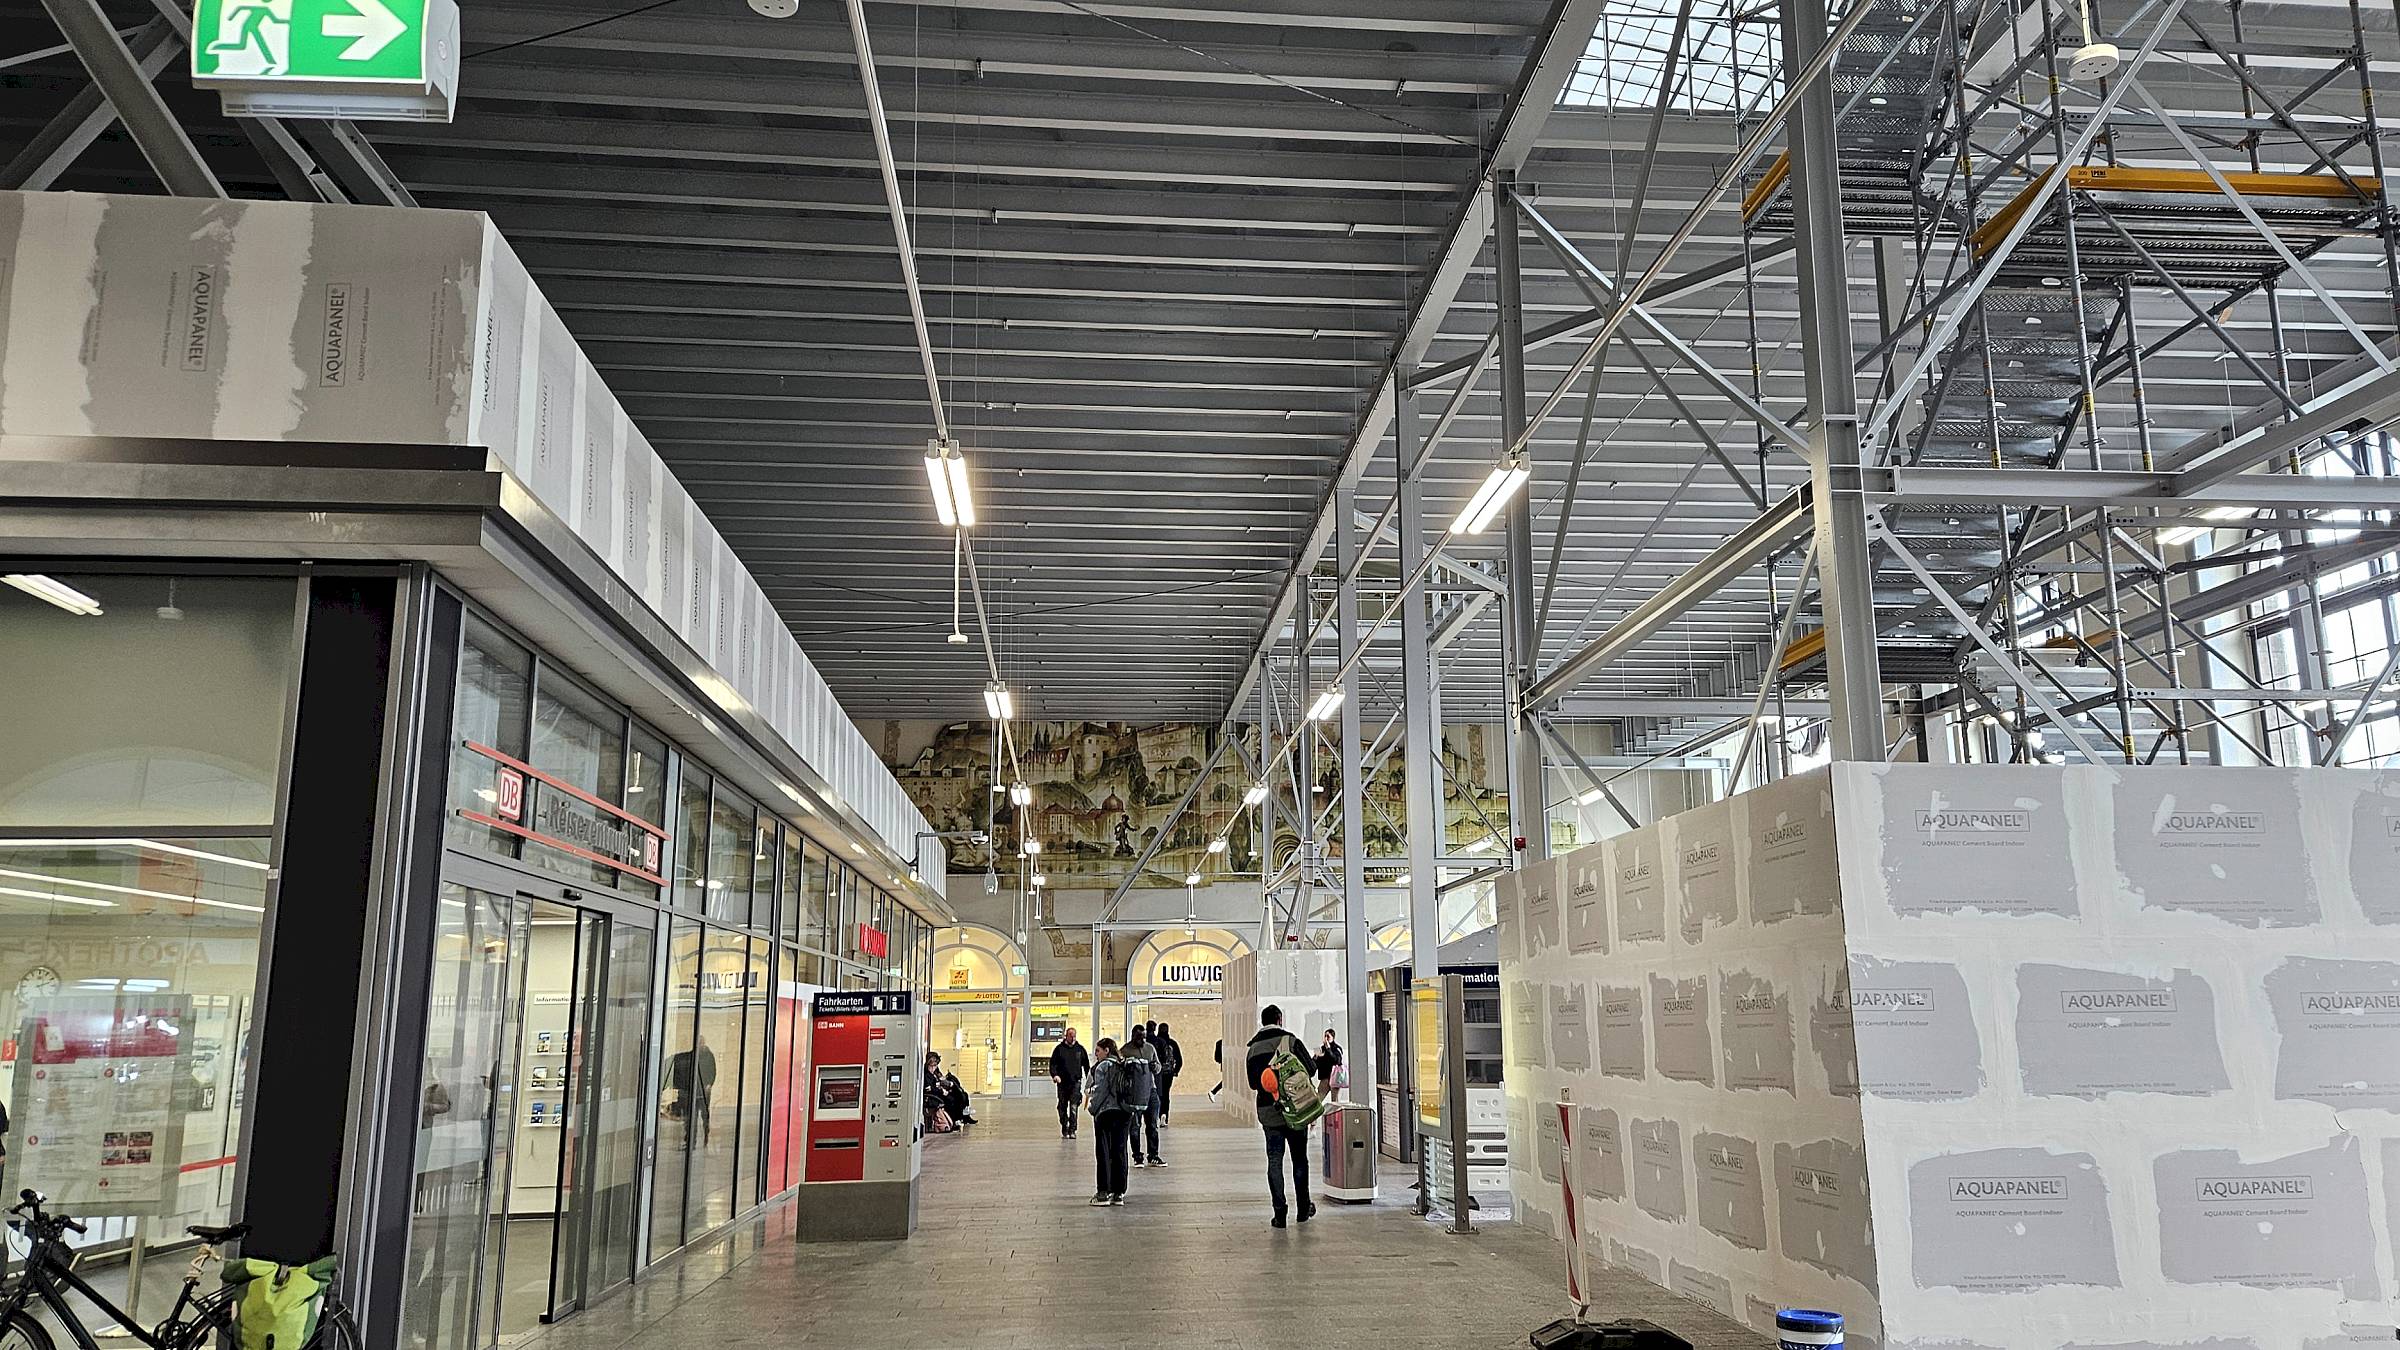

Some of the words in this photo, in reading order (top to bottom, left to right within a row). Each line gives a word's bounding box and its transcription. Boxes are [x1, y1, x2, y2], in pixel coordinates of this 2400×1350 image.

[326, 287, 345, 382] AQUAPANEL®
[502, 777, 518, 811] DB
[648, 840, 657, 866] DB
[1162, 965, 1222, 982] LUDWIG
[819, 997, 863, 1006] Fahrkarten
[2068, 993, 2171, 1010] AQUAPANEL®
[1955, 1180, 2062, 1197] AQUAPANEL®
[2202, 1180, 2306, 1198] AQUAPANEL®
